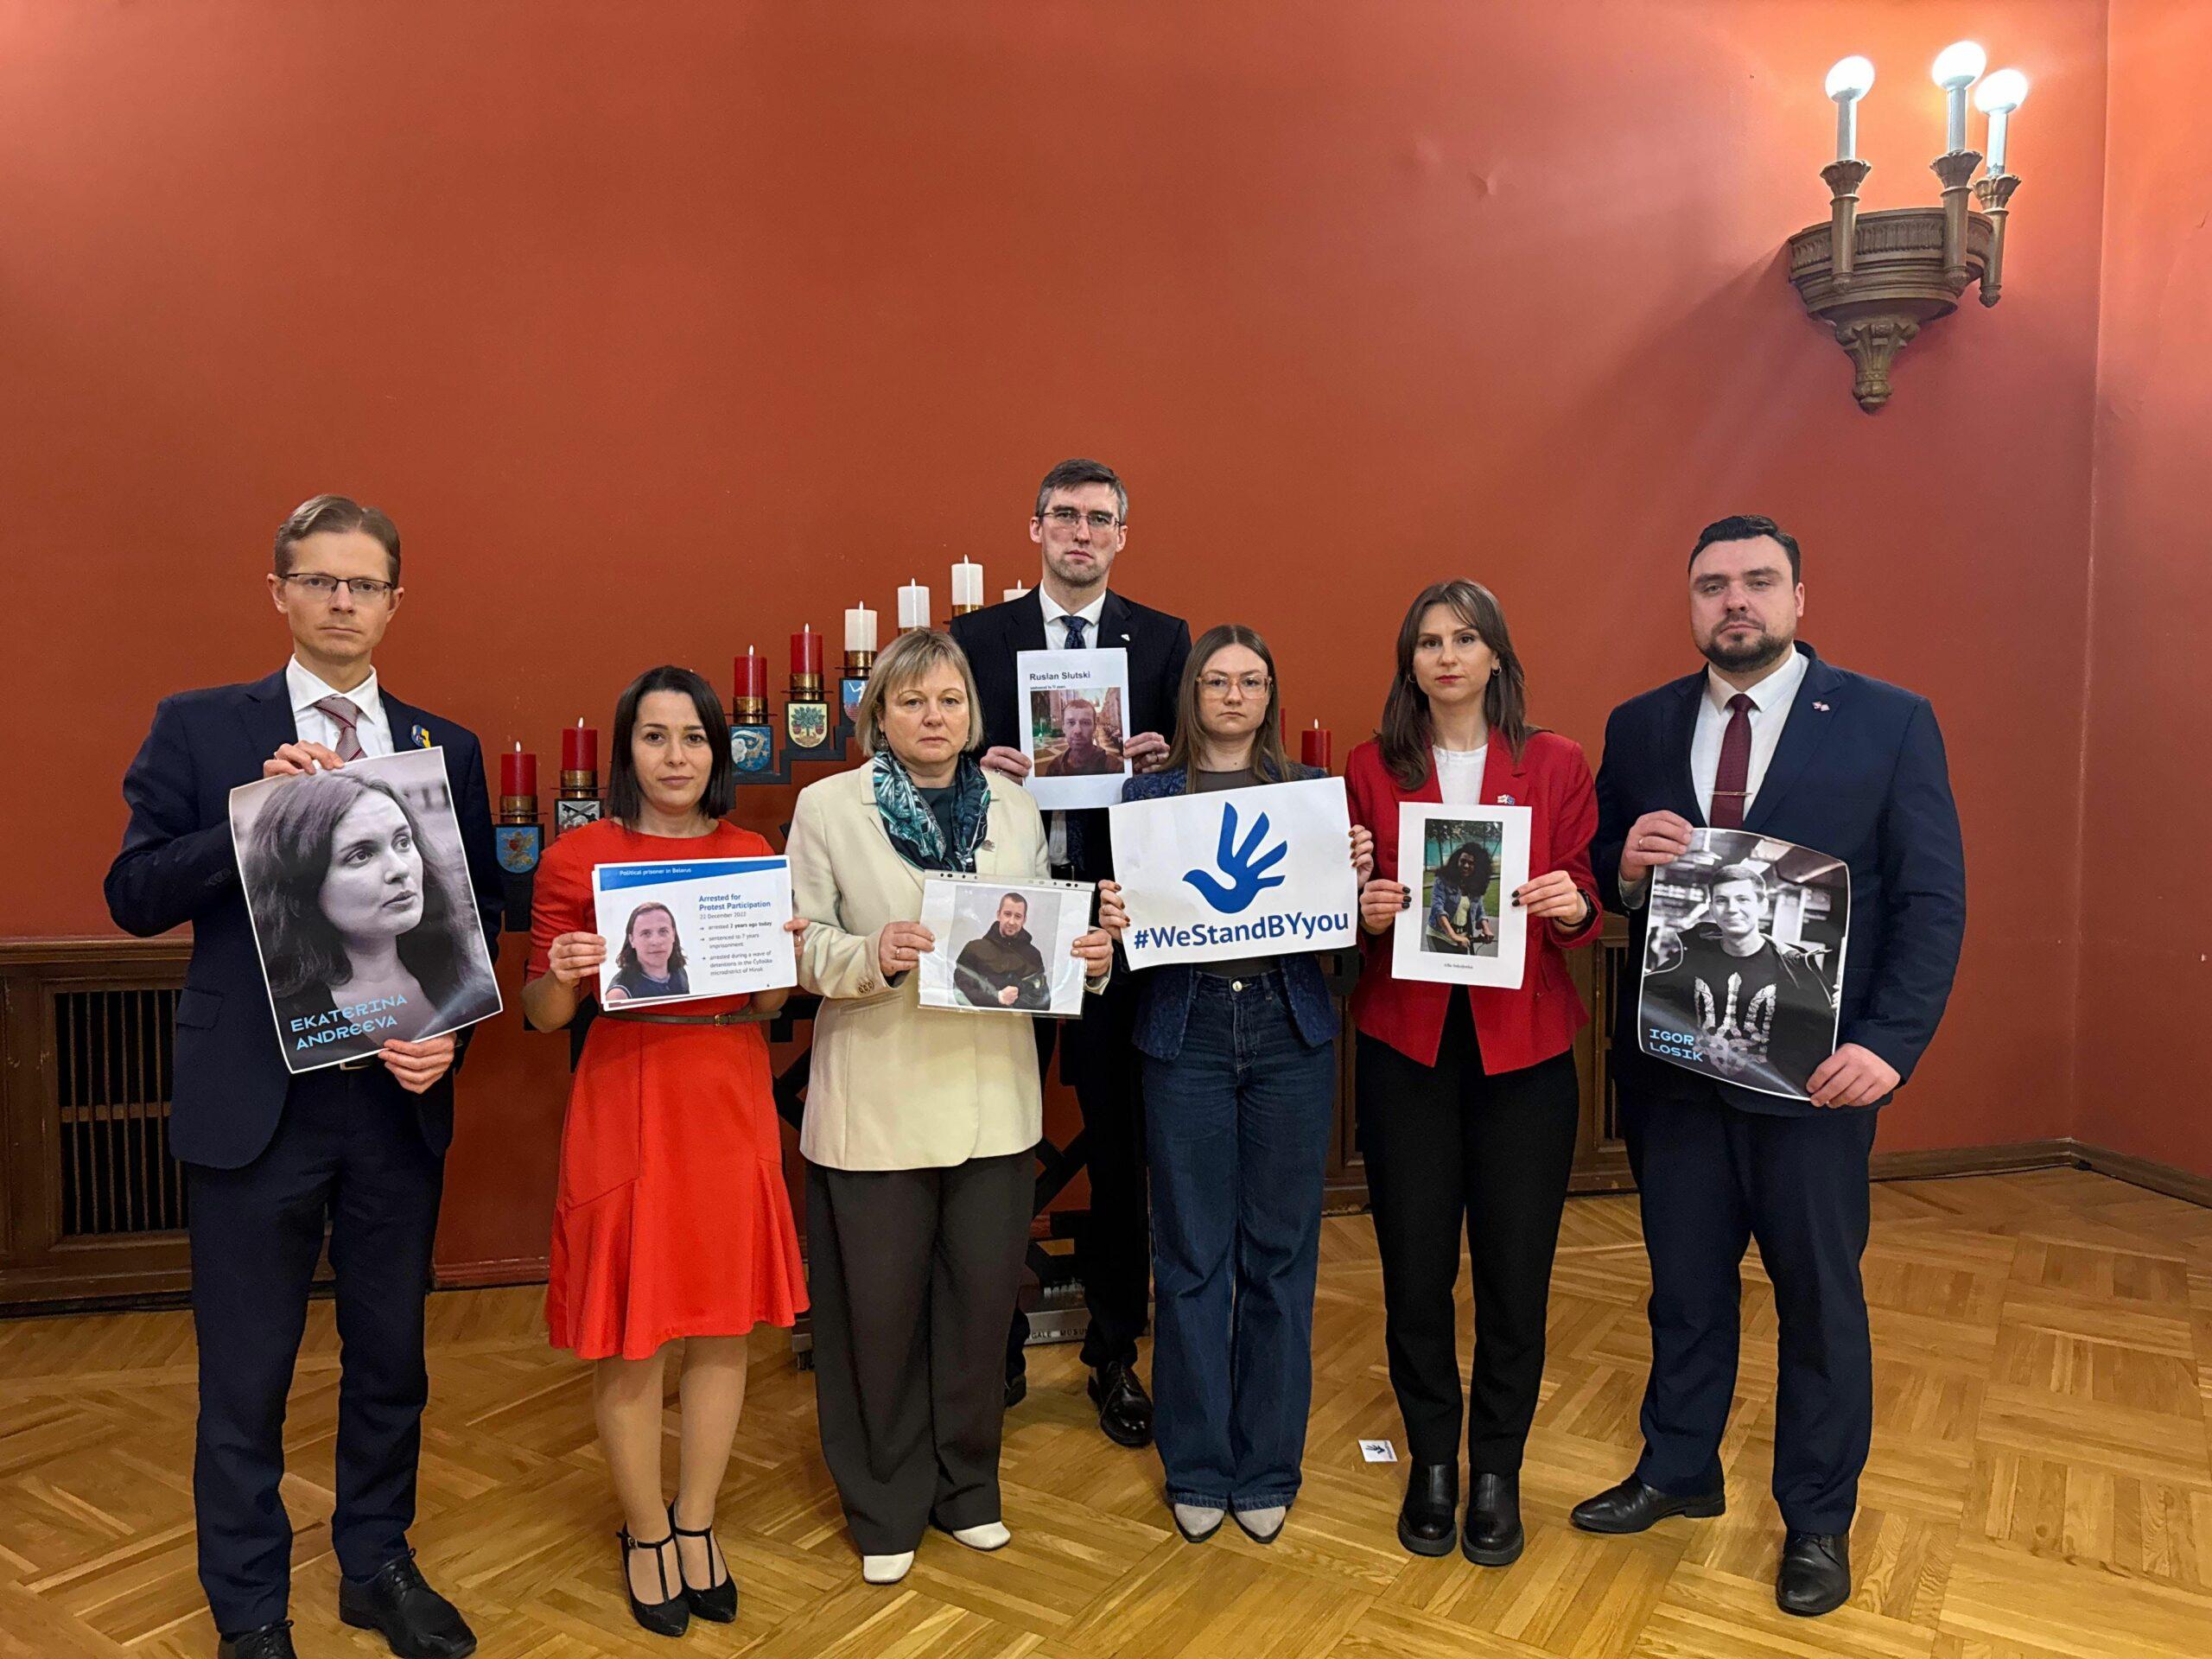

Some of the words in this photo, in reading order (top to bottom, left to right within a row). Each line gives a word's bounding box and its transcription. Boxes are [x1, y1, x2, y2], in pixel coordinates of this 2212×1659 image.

[1030, 672, 1059, 681] Ruslan
[1061, 671, 1090, 679] Slutski
[698, 893, 729, 902] Arrested
[699, 903, 725, 912] Protest
[1133, 912, 1349, 950] #WeStandBYyou
[290, 993, 408, 1033] EKATERINA
[296, 1014, 398, 1051] ANDREEVA
[1649, 1028, 1694, 1046] IGOR
[1649, 1041, 1703, 1063] LOSIK
